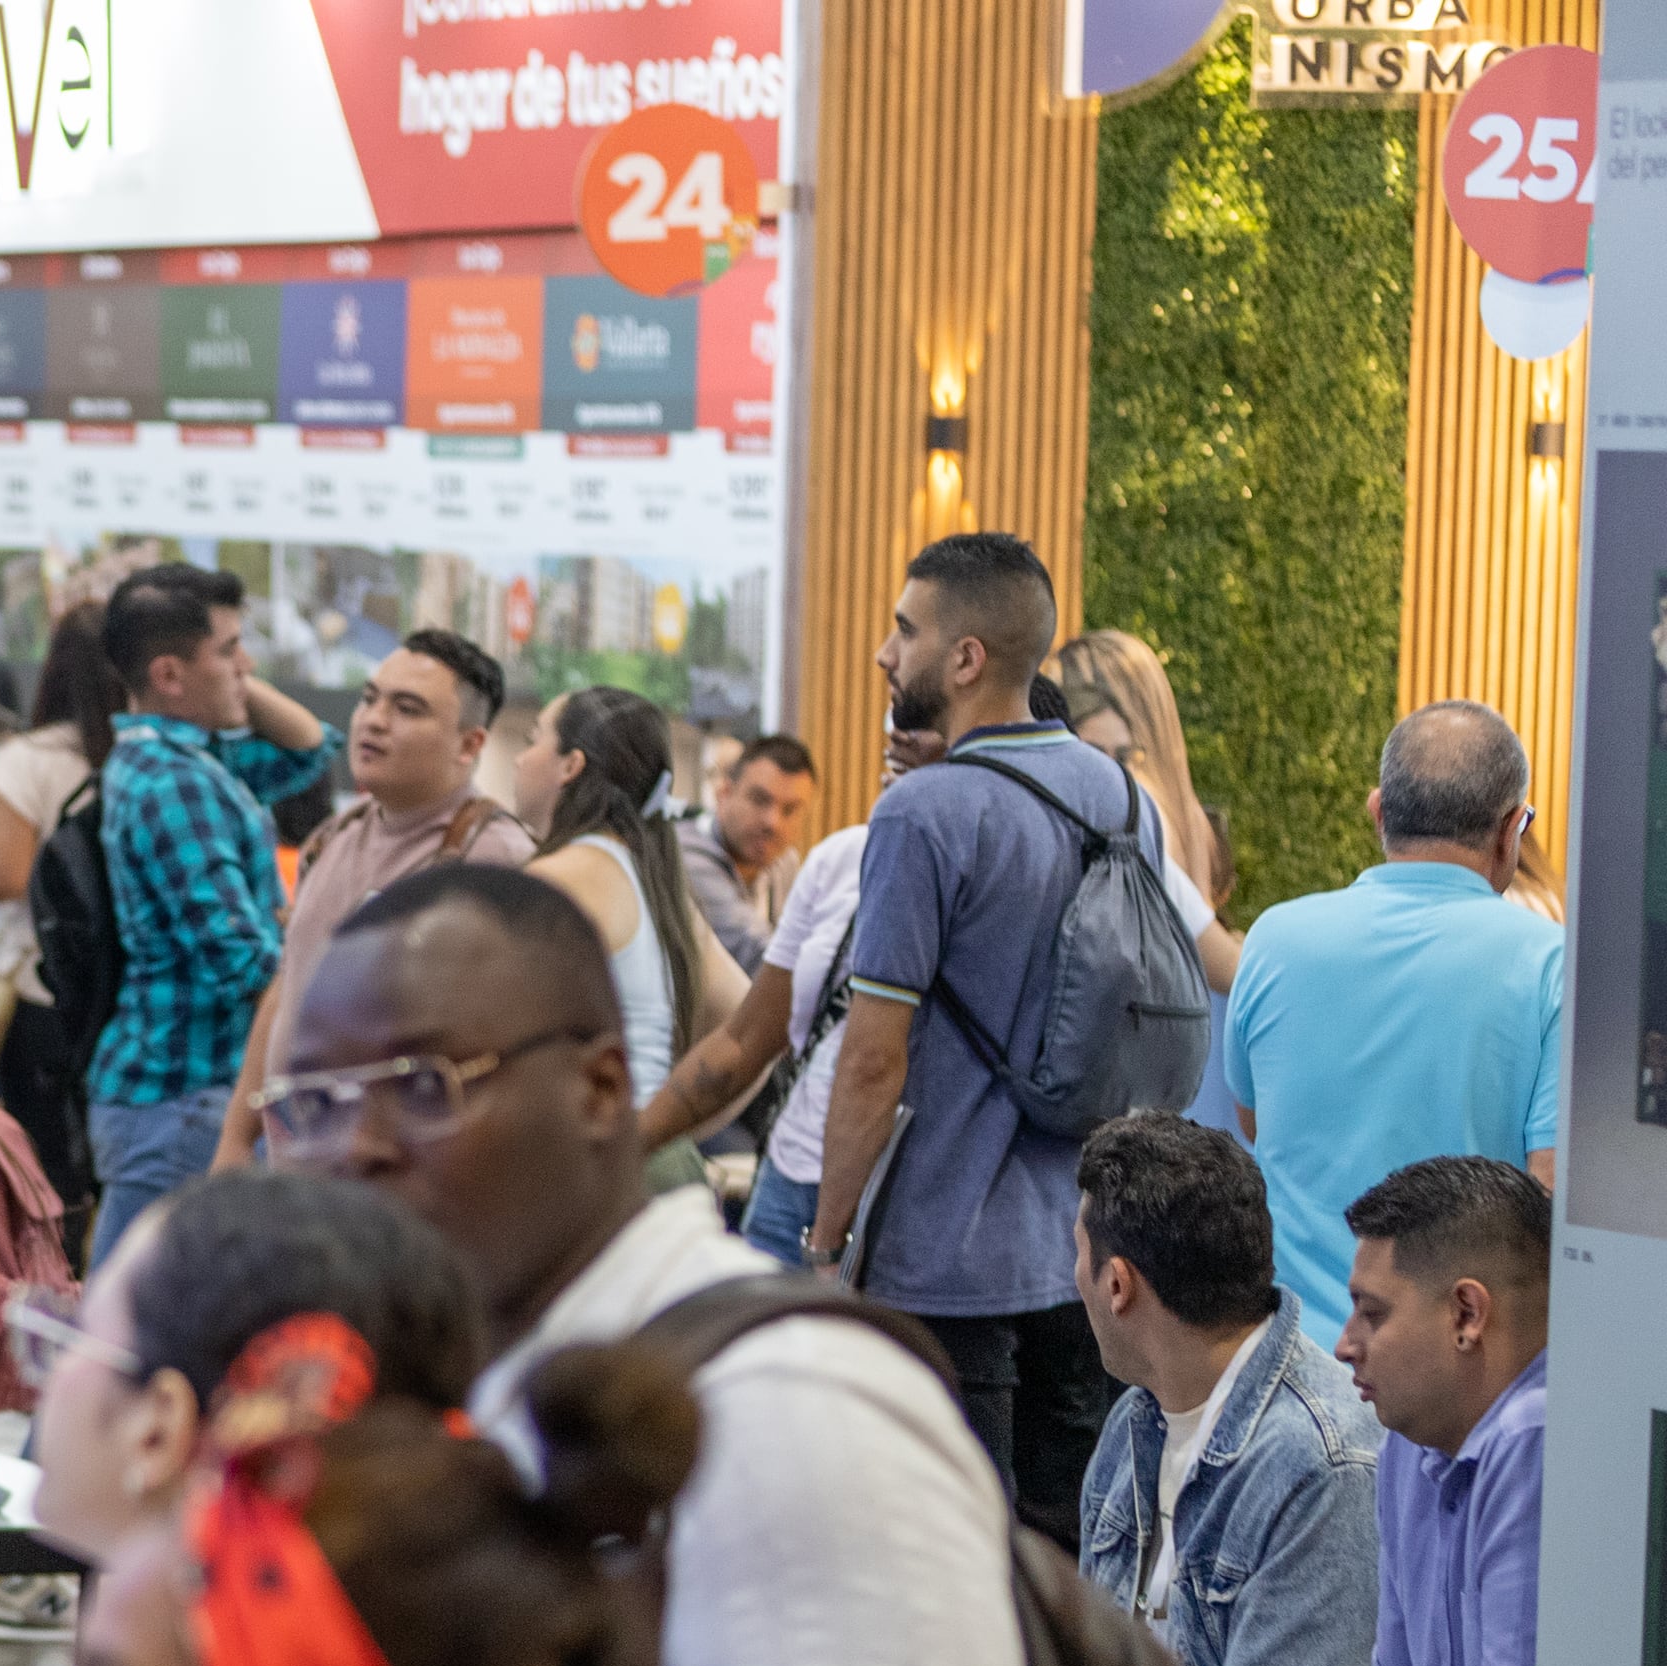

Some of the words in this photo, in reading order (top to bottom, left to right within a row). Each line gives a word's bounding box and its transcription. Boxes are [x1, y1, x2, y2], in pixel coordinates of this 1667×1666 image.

[400, 57, 511, 157] hogar
[513, 48, 565, 130] de
[567, 51, 632, 126] tus
[608, 152, 731, 242] 24
